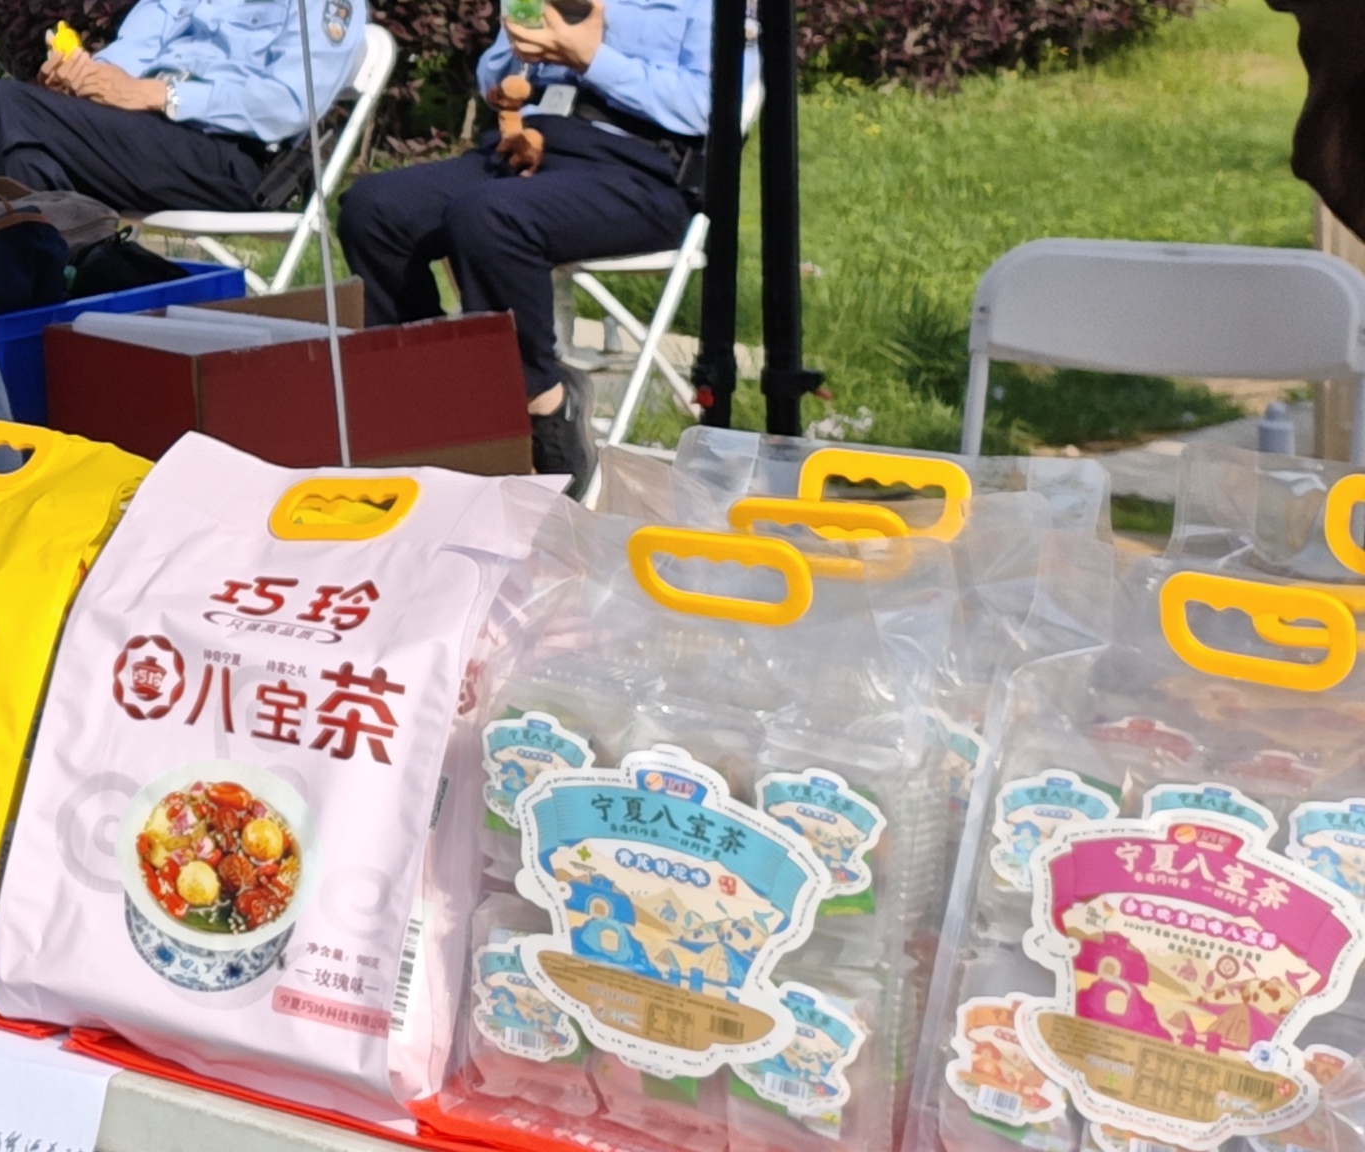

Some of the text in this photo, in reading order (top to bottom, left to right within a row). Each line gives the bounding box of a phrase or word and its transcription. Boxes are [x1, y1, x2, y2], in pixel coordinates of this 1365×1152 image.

[209, 576, 380, 631] 巧玲
[203, 649, 308, 678] 神奇宁夏 待客之礼
[184, 661, 406, 766] 八宝茶
[591, 794, 747, 855] 宁夏八宝茶
[1114, 841, 1291, 910] 宁夏八宝茶
[313, 968, 365, 996] 玫瑰味
[279, 994, 388, 1032] 宁夏巧玲科技有限公司
